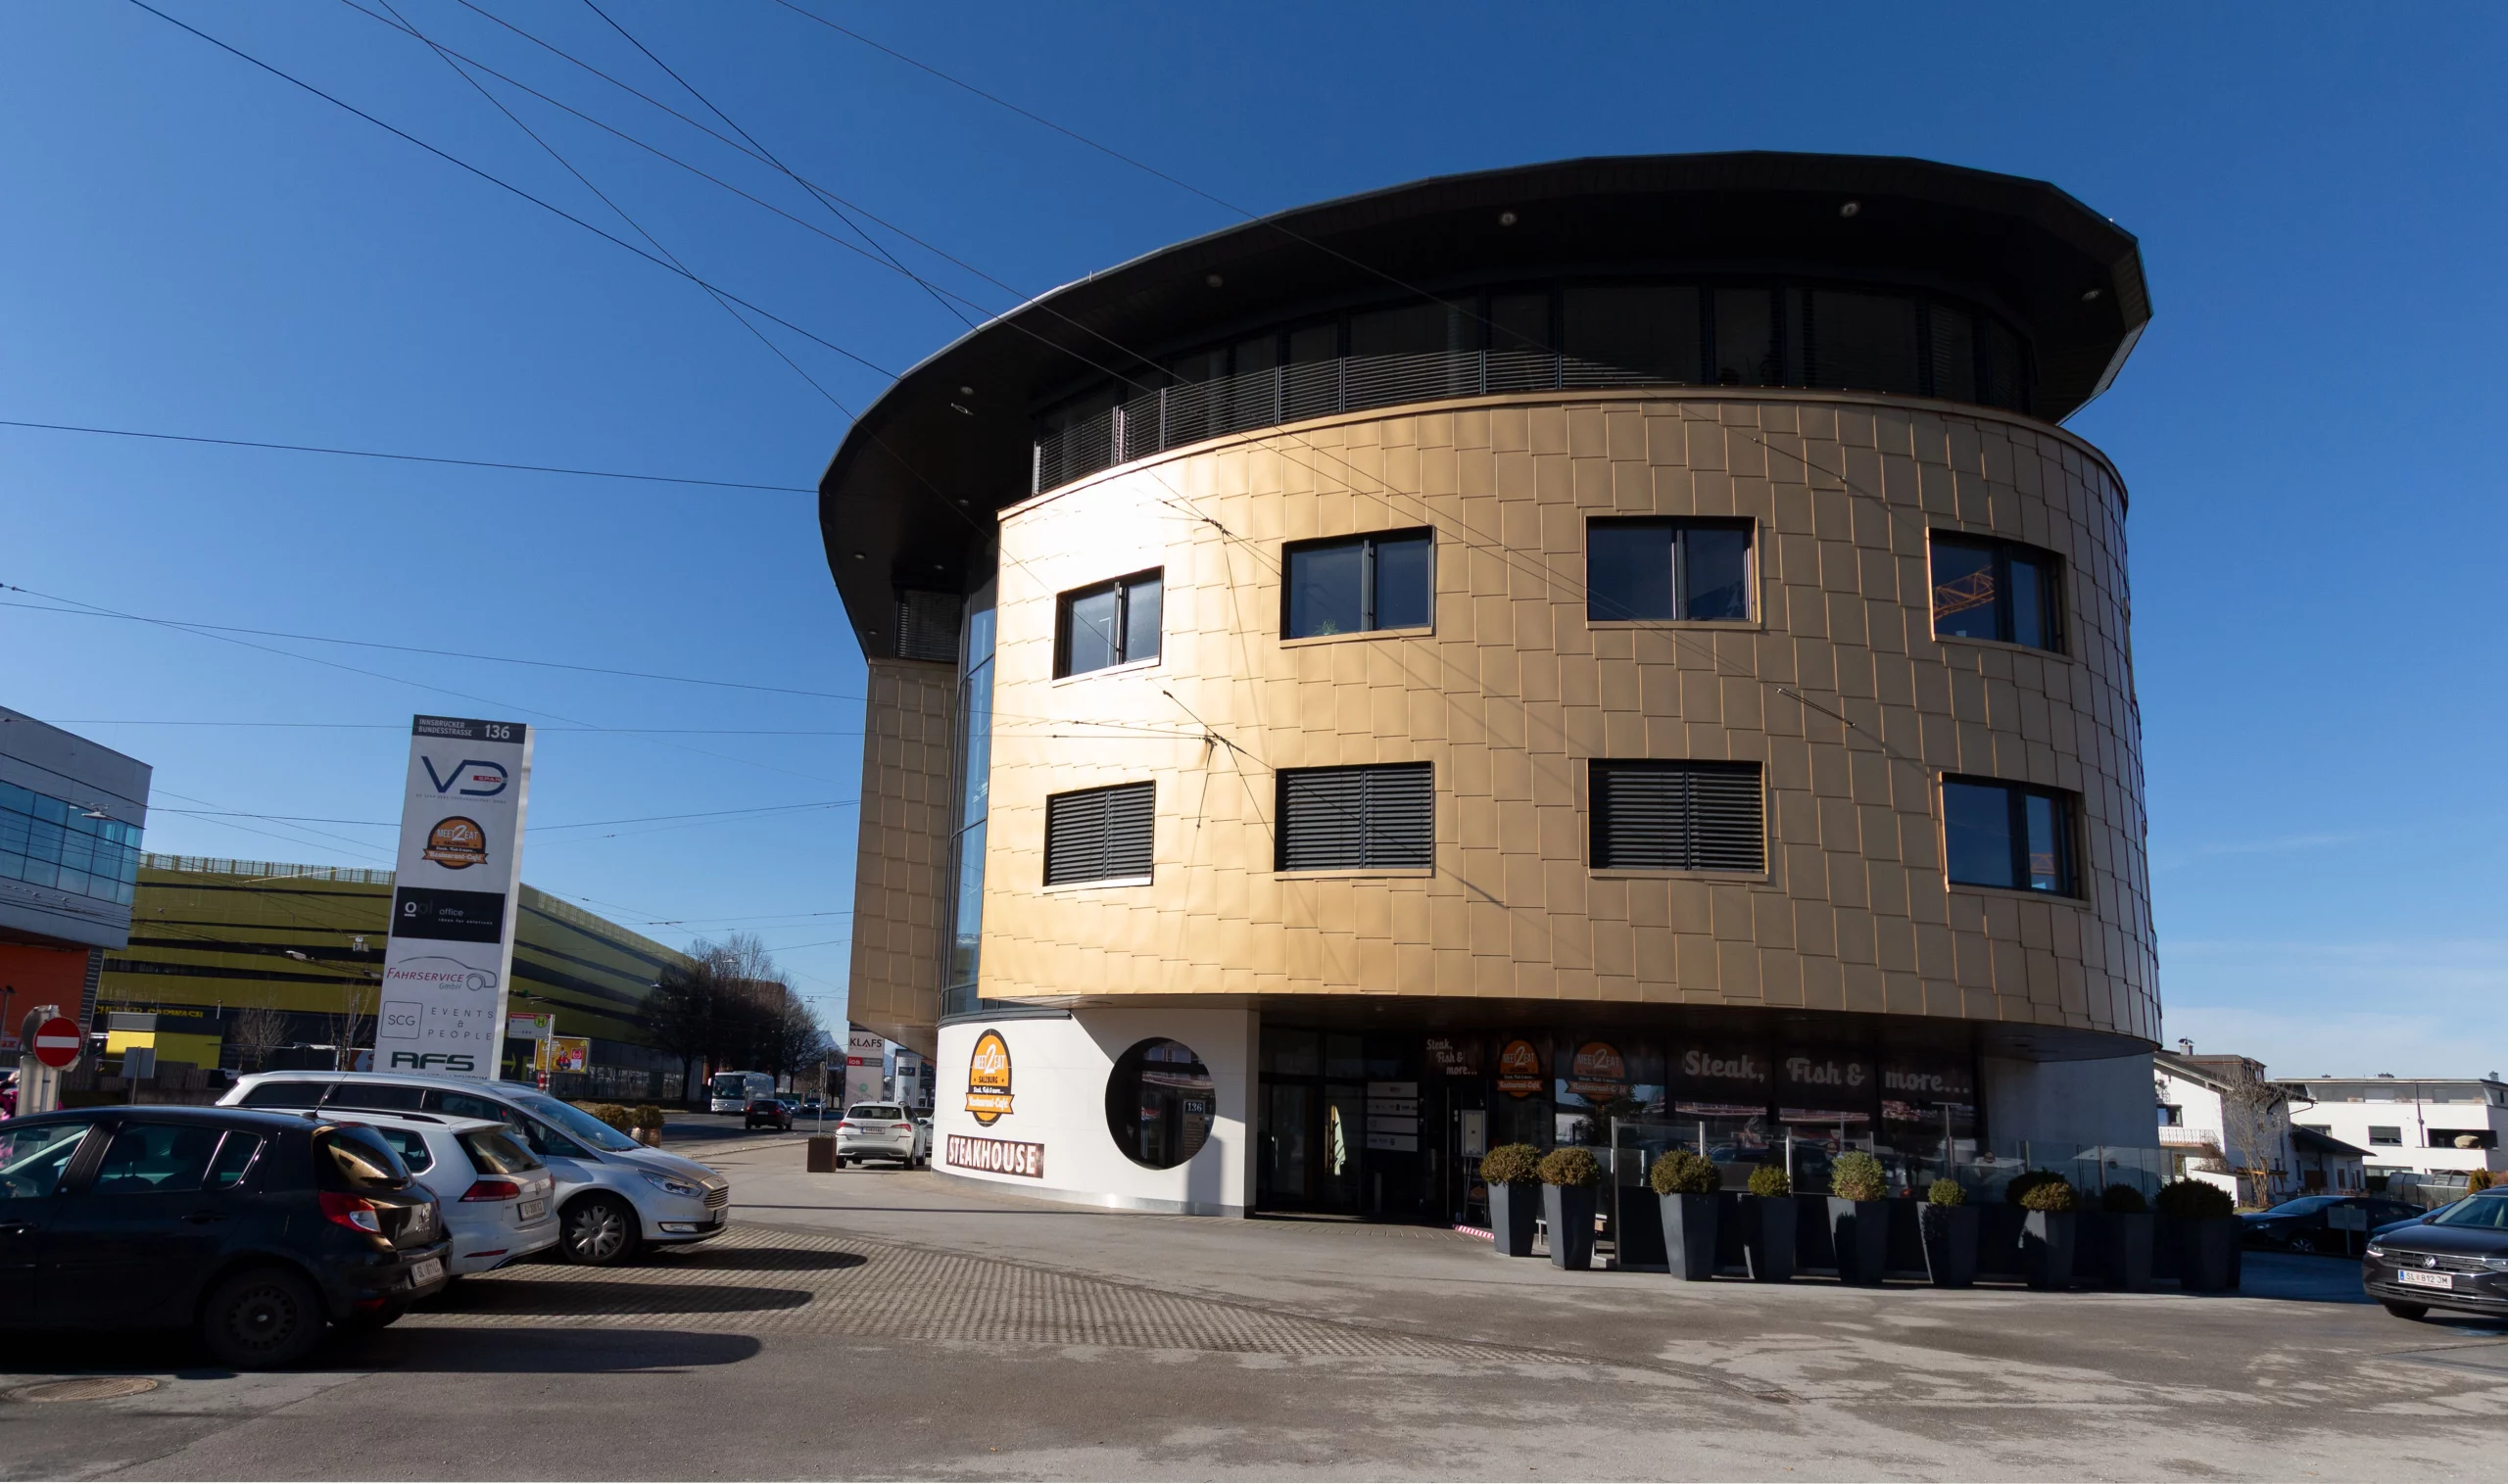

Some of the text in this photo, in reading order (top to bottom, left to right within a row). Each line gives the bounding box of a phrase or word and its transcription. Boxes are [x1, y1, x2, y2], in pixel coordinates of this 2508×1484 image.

[418, 718, 465, 729] INNSBRUCKER
[418, 726, 472, 736] BUNDESSTRASSE
[485, 724, 510, 740] 136
[439, 907, 464, 917] office
[386, 967, 465, 982] FAHRSERVICE
[431, 1007, 494, 1019] EVENTS
[387, 1014, 416, 1027] SCG
[427, 1029, 492, 1041] PEOPLE
[850, 1038, 882, 1047] KLAFS
[1425, 1038, 1453, 1051] Steak,
[391, 1051, 475, 1072] AFS
[1436, 1051, 1464, 1063] Fish &
[1446, 1066, 1477, 1076] more...
[1684, 1050, 1970, 1094] Steak, Fish & more...
[1187, 1102, 1202, 1113] 136
[948, 1136, 1037, 1175] STEAKHOUSE
